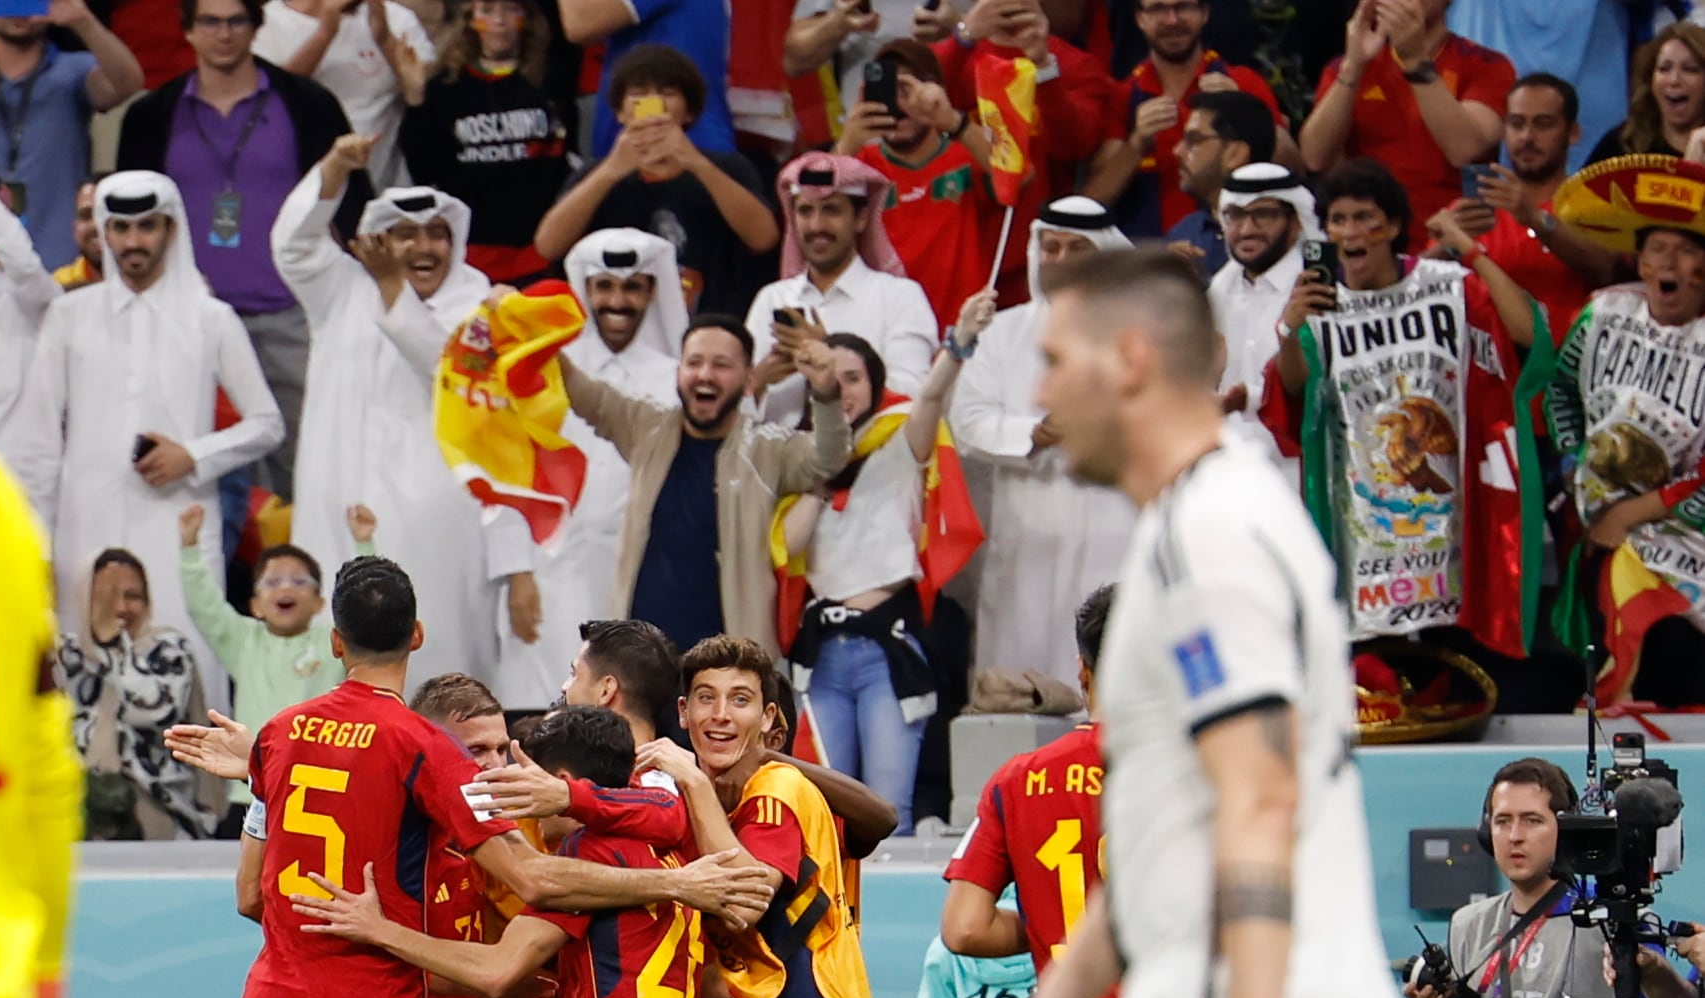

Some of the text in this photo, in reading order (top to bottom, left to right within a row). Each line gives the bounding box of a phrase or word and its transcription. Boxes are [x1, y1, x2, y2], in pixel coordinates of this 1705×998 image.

[1358, 556, 1394, 576] SEE
[1404, 550, 1445, 570] YOU
[289, 714, 377, 749] SERGIO
[1026, 768, 1054, 796] M.
[278, 763, 350, 902] 5
